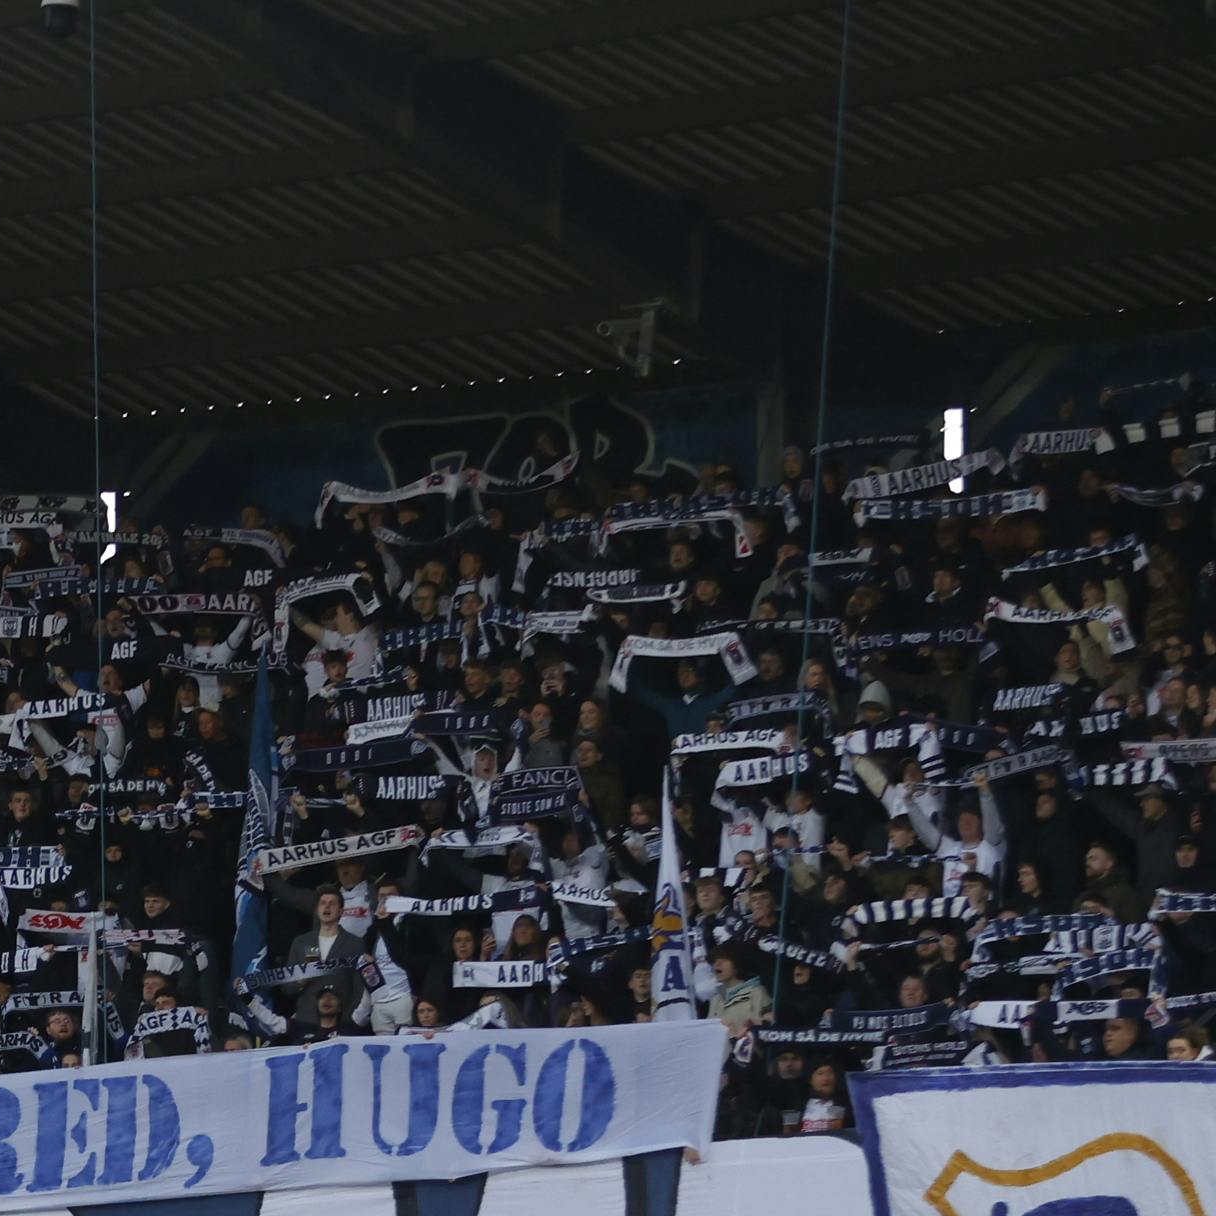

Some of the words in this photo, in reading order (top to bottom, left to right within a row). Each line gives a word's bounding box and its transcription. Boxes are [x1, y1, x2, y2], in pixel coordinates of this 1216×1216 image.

[887, 459, 963, 495] AARHUS
[244, 569, 273, 587] AGF
[110, 640, 138, 660] AGF
[28, 693, 106, 717] AARHUS
[993, 681, 1063, 712] AARHUS
[874, 727, 904, 750] AGF
[734, 754, 810, 781] AARHUS
[267, 839, 352, 868] AARHUS
[357, 826, 397, 854] AGF
[411, 895, 493, 913] AARHUS
[497, 961, 544, 984] AARH
[261, 1038, 617, 1167] HUGO
